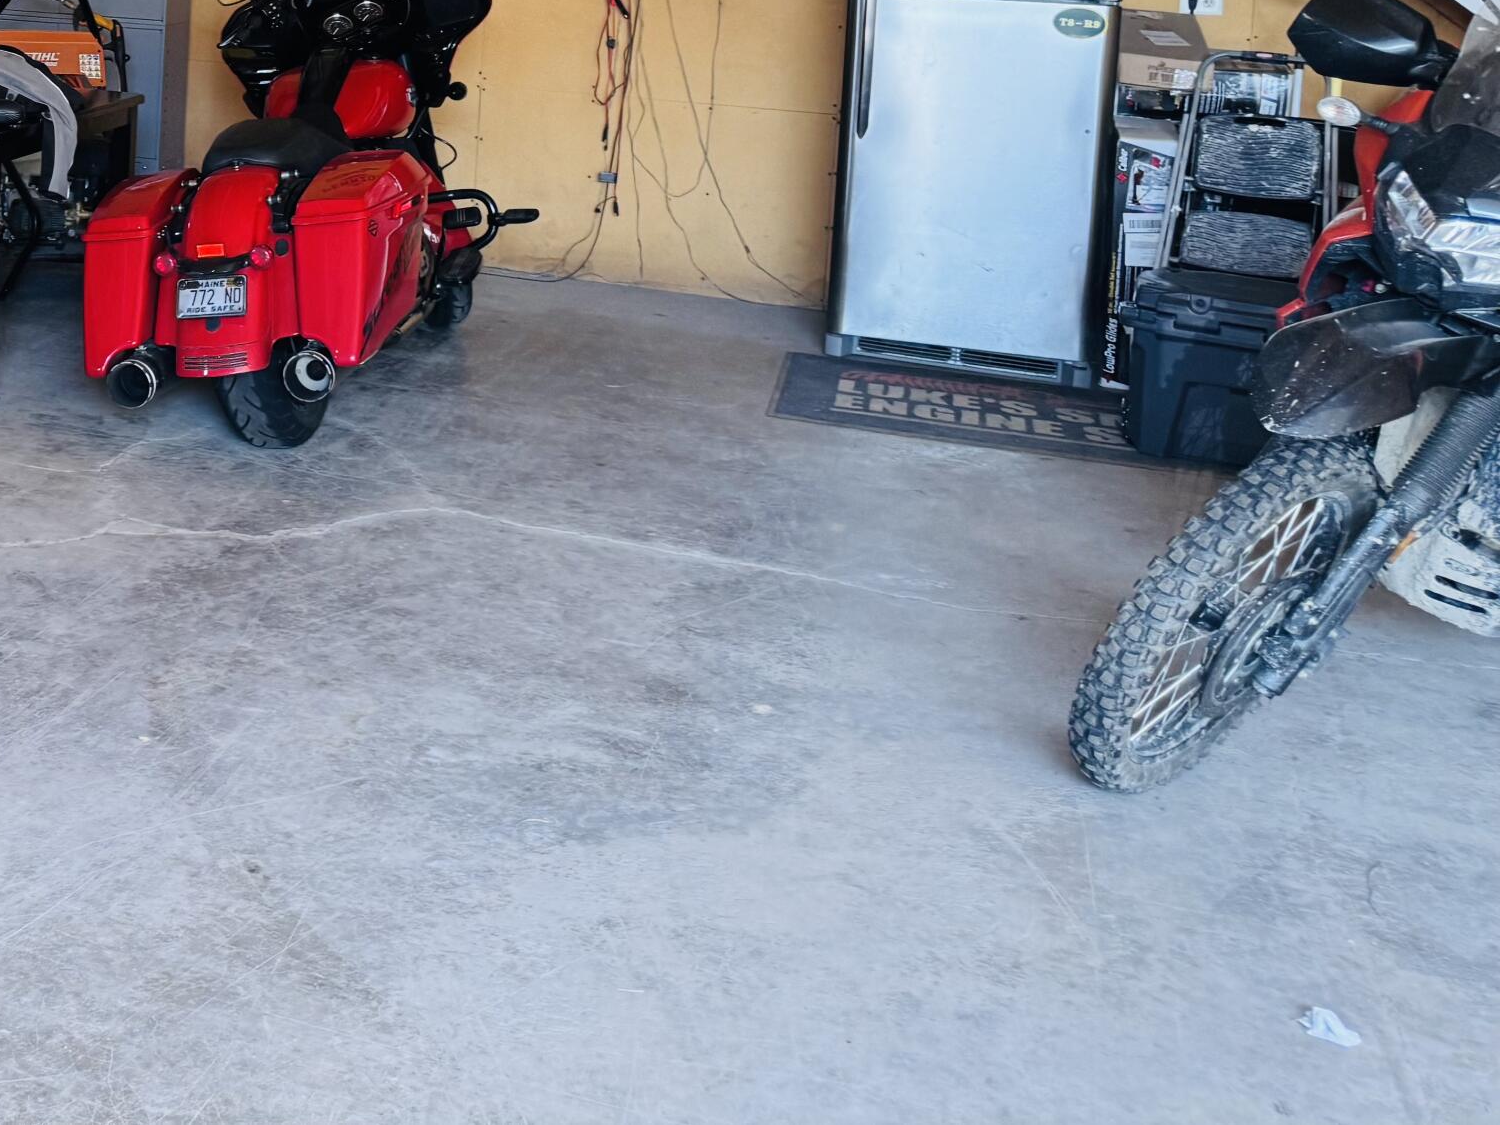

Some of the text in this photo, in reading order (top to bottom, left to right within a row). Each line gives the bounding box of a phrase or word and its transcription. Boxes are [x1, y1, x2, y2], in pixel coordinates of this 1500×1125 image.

[190, 289, 215, 307] 772
[212, 304, 235, 312] SAFE
[837, 378, 1038, 416] LUKE'S
[834, 393, 1066, 437] ENGINE
